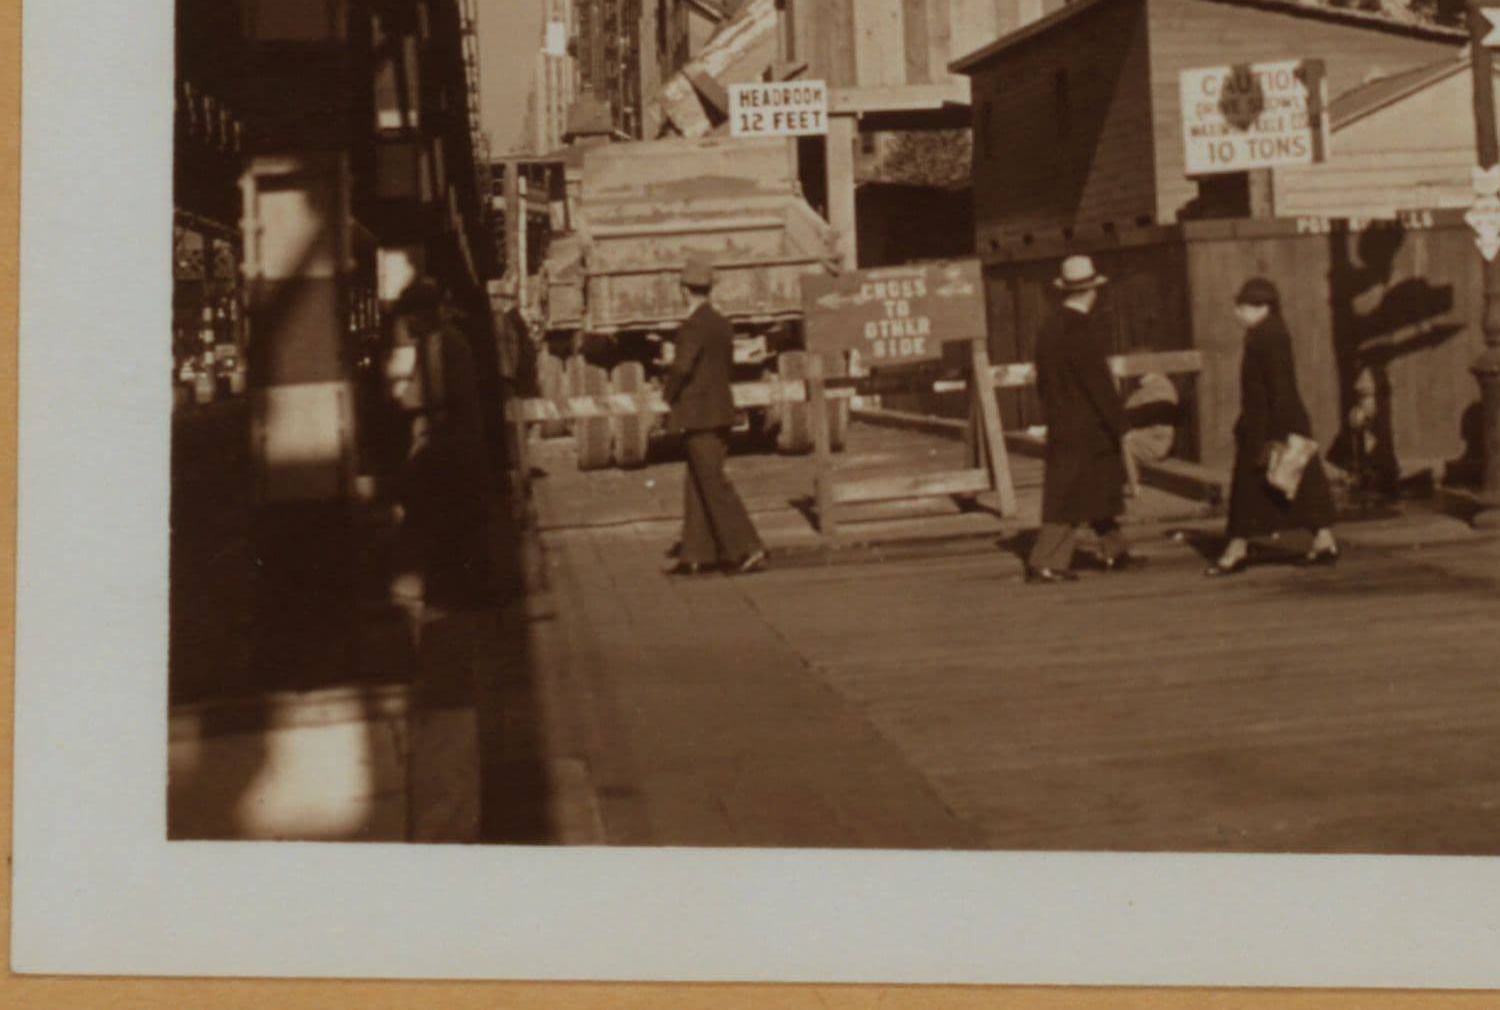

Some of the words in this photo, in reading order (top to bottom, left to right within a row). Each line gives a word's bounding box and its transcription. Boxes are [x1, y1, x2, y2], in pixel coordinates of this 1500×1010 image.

[740, 87, 822, 107] HEADROOM
[741, 112, 763, 132] 12
[773, 110, 821, 130] FEET
[1206, 141, 1235, 164] 10
[1248, 135, 1306, 160] TONS
[861, 278, 927, 299] CROSS
[884, 300, 909, 318] TO
[864, 317, 929, 339] OTHER
[872, 337, 925, 357] SIDE
